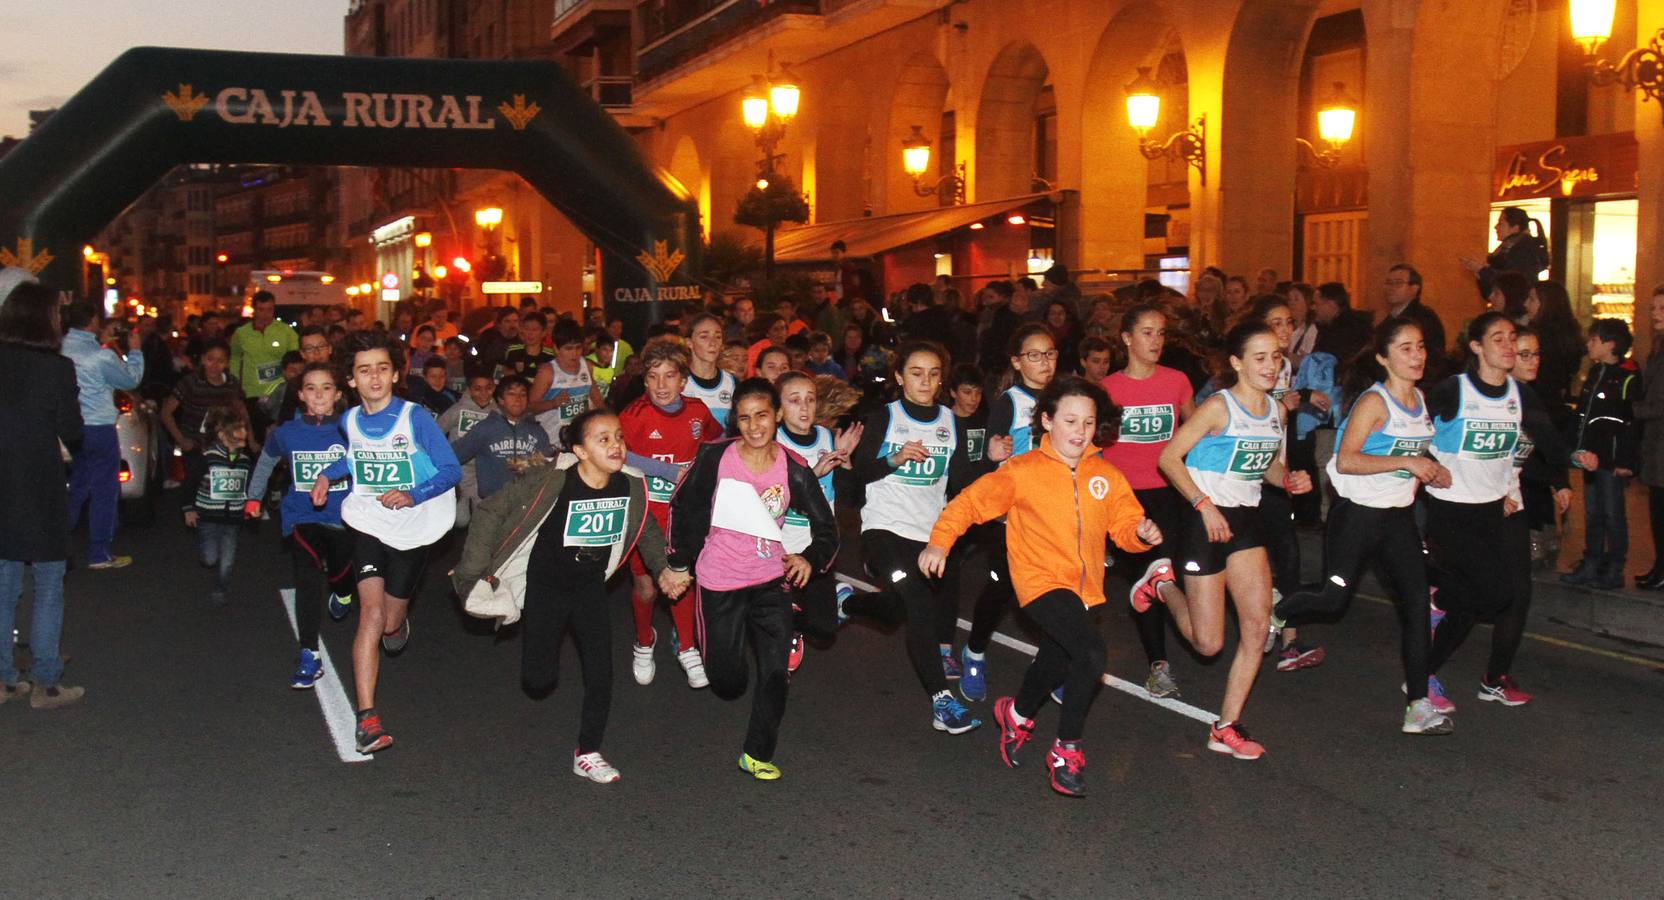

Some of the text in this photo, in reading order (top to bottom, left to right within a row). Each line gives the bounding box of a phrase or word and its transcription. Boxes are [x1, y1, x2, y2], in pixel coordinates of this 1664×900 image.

[216, 87, 496, 130] CAJA RURAL
[615, 285, 703, 303] CAJA RURAL
[1129, 416, 1163, 433] 519
[1471, 421, 1490, 430] CAJA
[1242, 442, 1260, 450] CAJA
[1472, 432, 1507, 450] 541
[296, 452, 314, 461] CAJA
[357, 451, 406, 461] CAJA RURAL
[1240, 452, 1274, 470] 232
[301, 463, 328, 481] 52
[363, 462, 401, 482] 572
[898, 456, 936, 475] 410
[218, 478, 242, 491] 280
[576, 500, 625, 512] CAJA RURAL
[577, 512, 615, 534] 201
